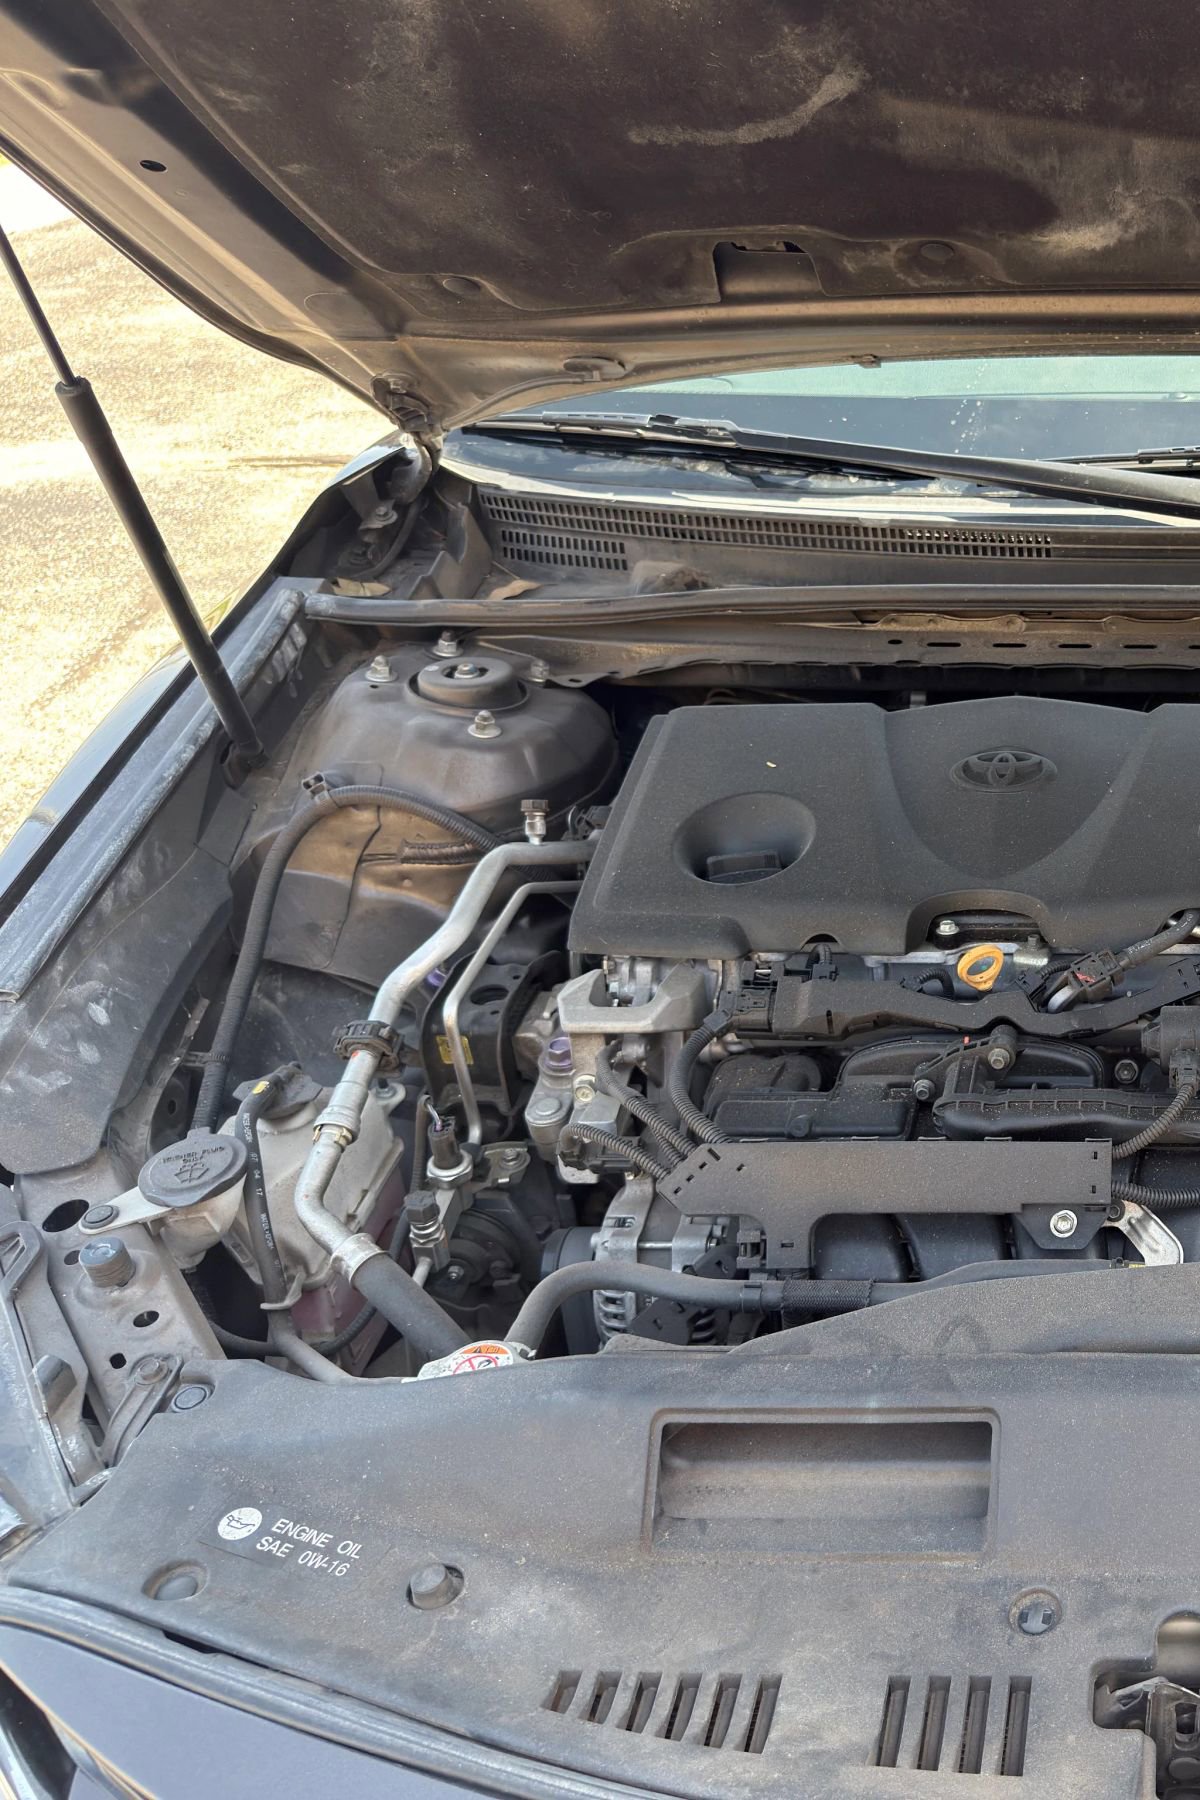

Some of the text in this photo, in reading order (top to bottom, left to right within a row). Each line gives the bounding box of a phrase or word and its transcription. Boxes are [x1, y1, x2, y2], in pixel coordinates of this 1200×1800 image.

[256, 1536, 350, 1576] SAE 0W-16
[272, 1518, 363, 1559] ENGINE OIL
